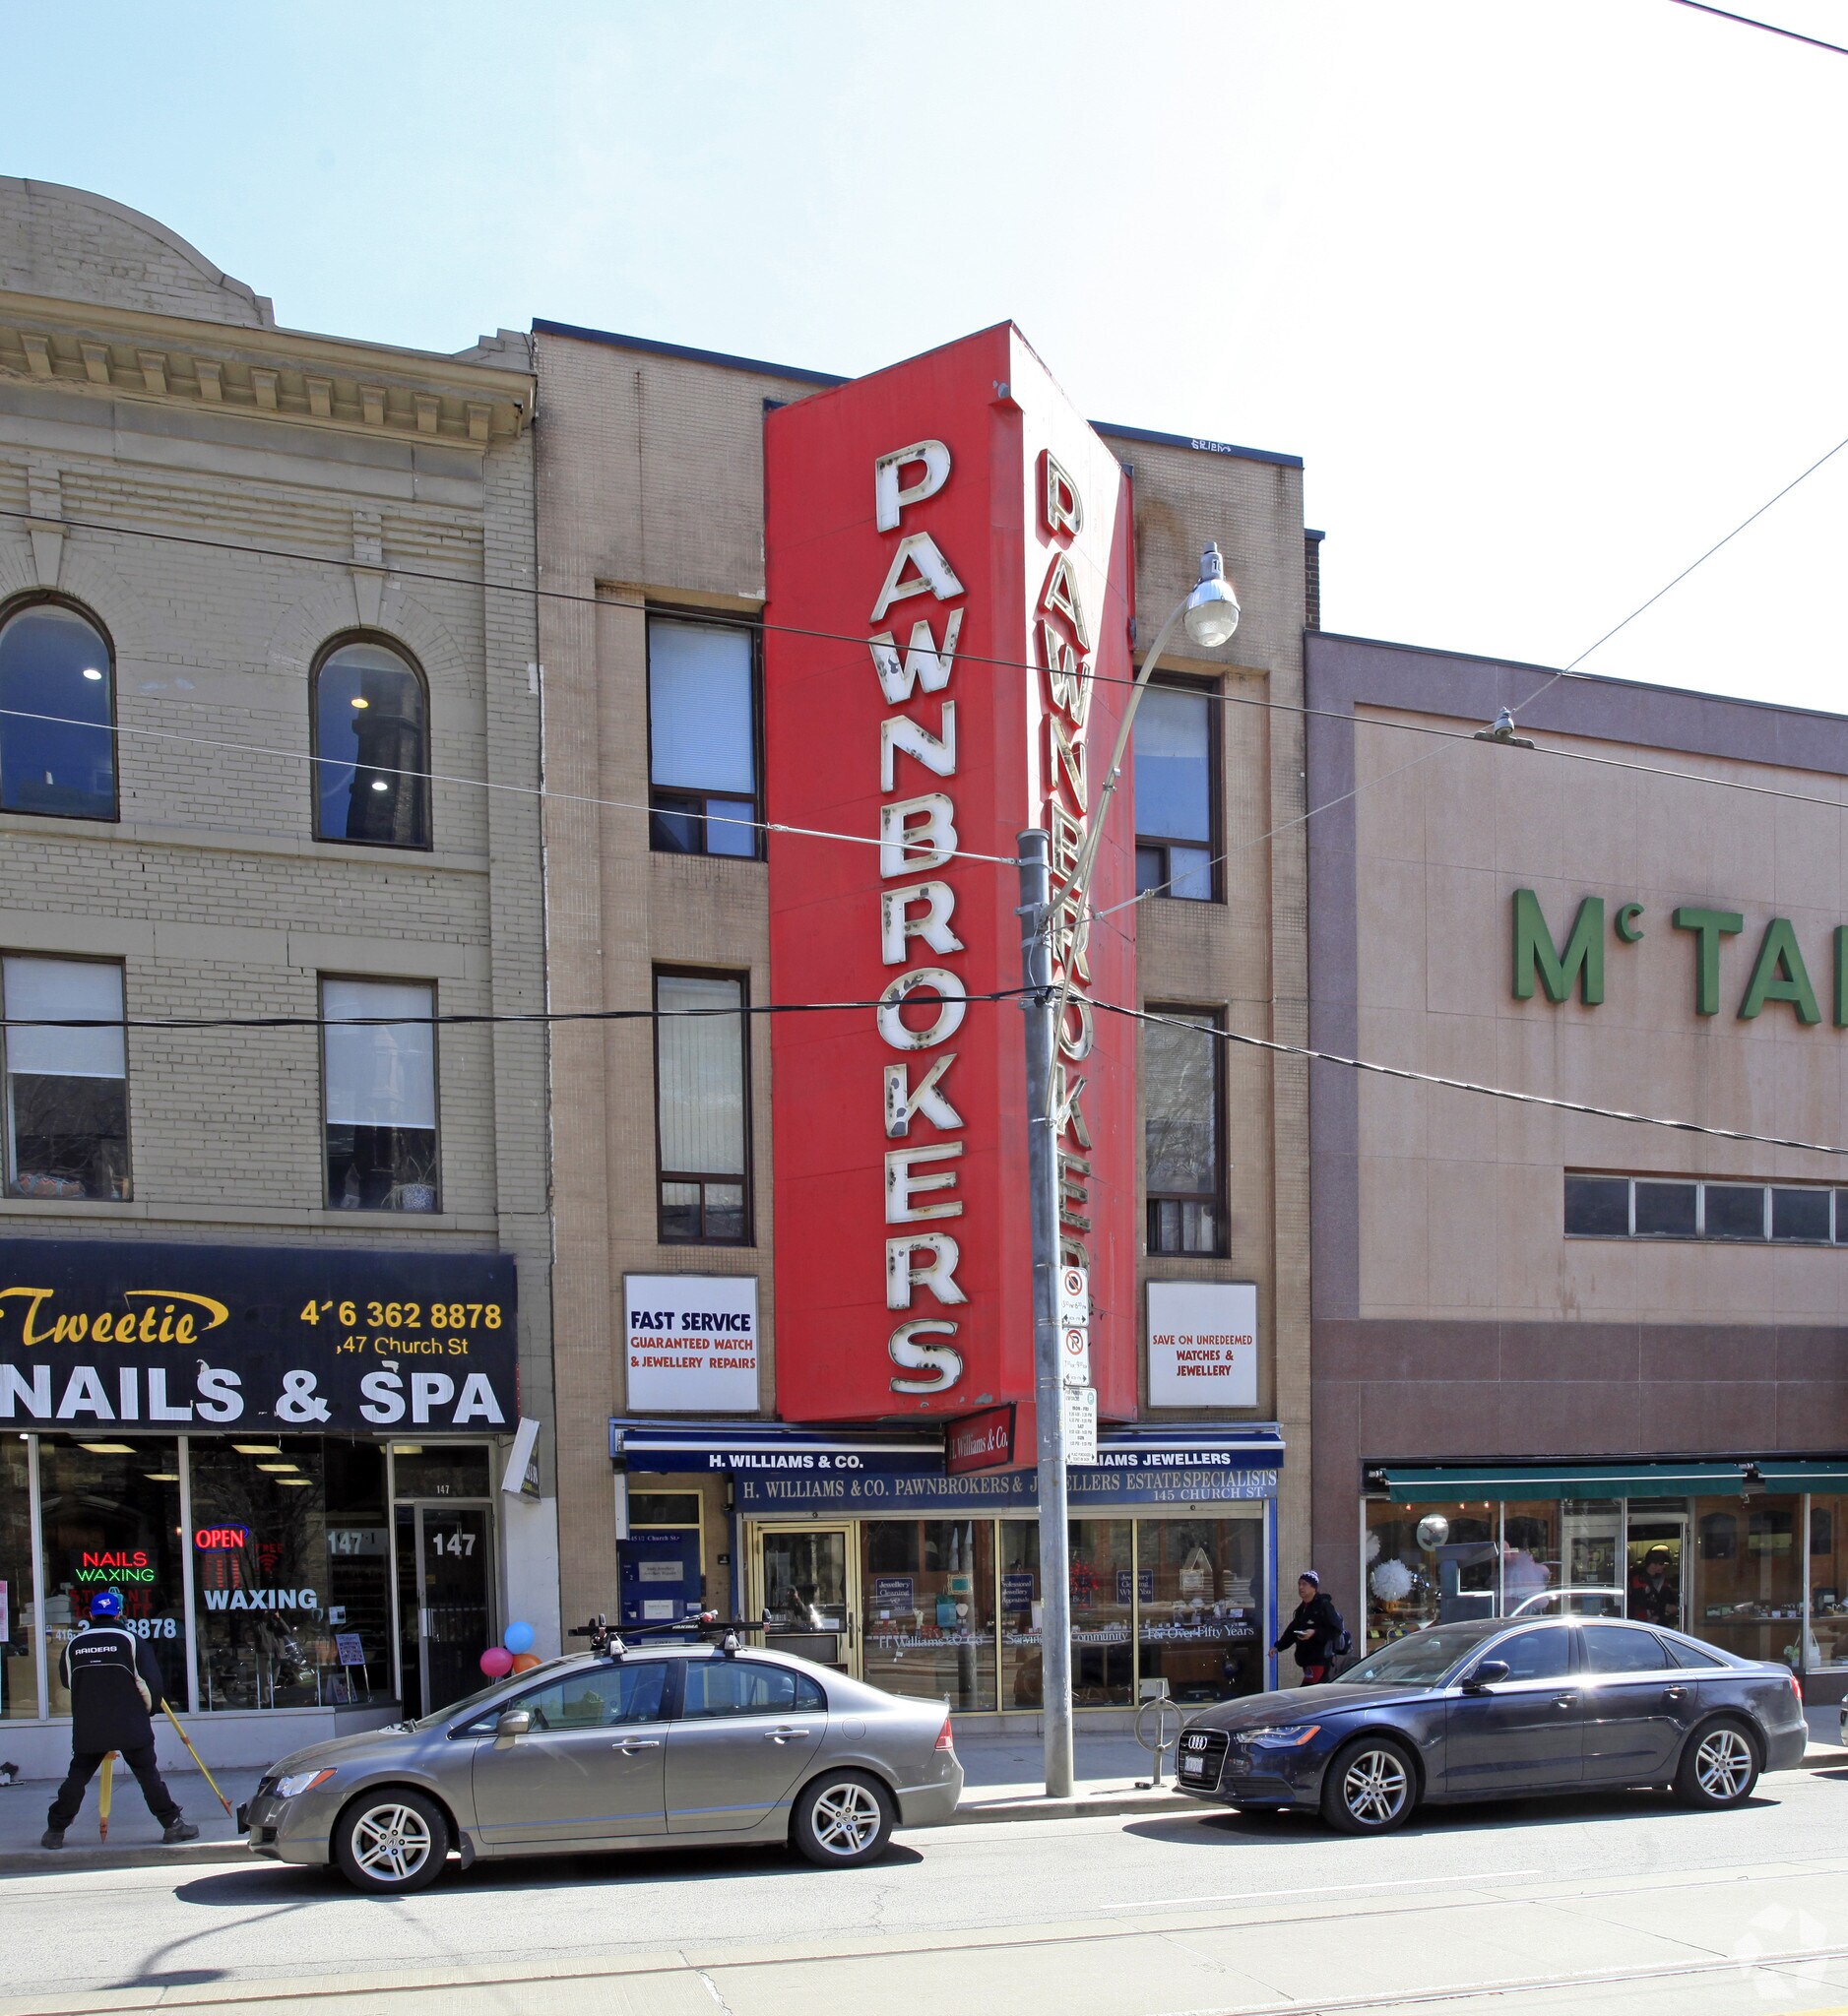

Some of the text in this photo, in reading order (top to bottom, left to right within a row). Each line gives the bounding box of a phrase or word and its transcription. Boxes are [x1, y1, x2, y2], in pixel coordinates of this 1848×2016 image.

[869, 439, 968, 1395] PAWNBROKERS
[0, 1287, 228, 1346] Tweetie
[367, 1301, 421, 1328] 362
[430, 1303, 502, 1329] 8878
[631, 1311, 751, 1331] FAST SERVICE
[336, 1336, 469, 1355] 47 Church St
[630, 1337, 753, 1351] GUARANTEED WATCH
[1153, 1335, 1252, 1345] SAVE ON UNREDEEMED
[630, 1356, 756, 1369] & JEWELLERY REPAIRS
[1177, 1350, 1234, 1360] WATCHES &
[1177, 1365, 1232, 1376] JEWELLERY
[0, 1363, 506, 1424] NAILS & SPA
[957, 1433, 987, 1458] Williams
[995, 1425, 1008, 1449] Co.
[710, 1455, 863, 1468] H. WILLIAMS & CO.
[1097, 1454, 1138, 1466] IAMS
[1143, 1453, 1231, 1466] JEWELLERS
[436, 1484, 450, 1494] 147
[743, 1470, 1277, 1498] H. WILLIAMS & CO. PAWNBROKERS & JELLERS ESTATE SPECIALISTS
[1153, 1486, 1268, 1500] 145 CHURCH ST.
[195, 1529, 245, 1548] OPEN
[328, 1531, 363, 1554] 147
[432, 1533, 477, 1555] 147
[83, 1551, 148, 1567] NAILS
[76, 1568, 155, 1582] WAXING
[204, 1589, 318, 1609] WAXING
[1168, 1626, 1193, 1639] Over
[1197, 1625, 1223, 1638] Fifty
[1223, 1623, 1254, 1636] Years
[893, 1634, 944, 1649] Williams
[75, 1645, 117, 1656] RAIDERS
